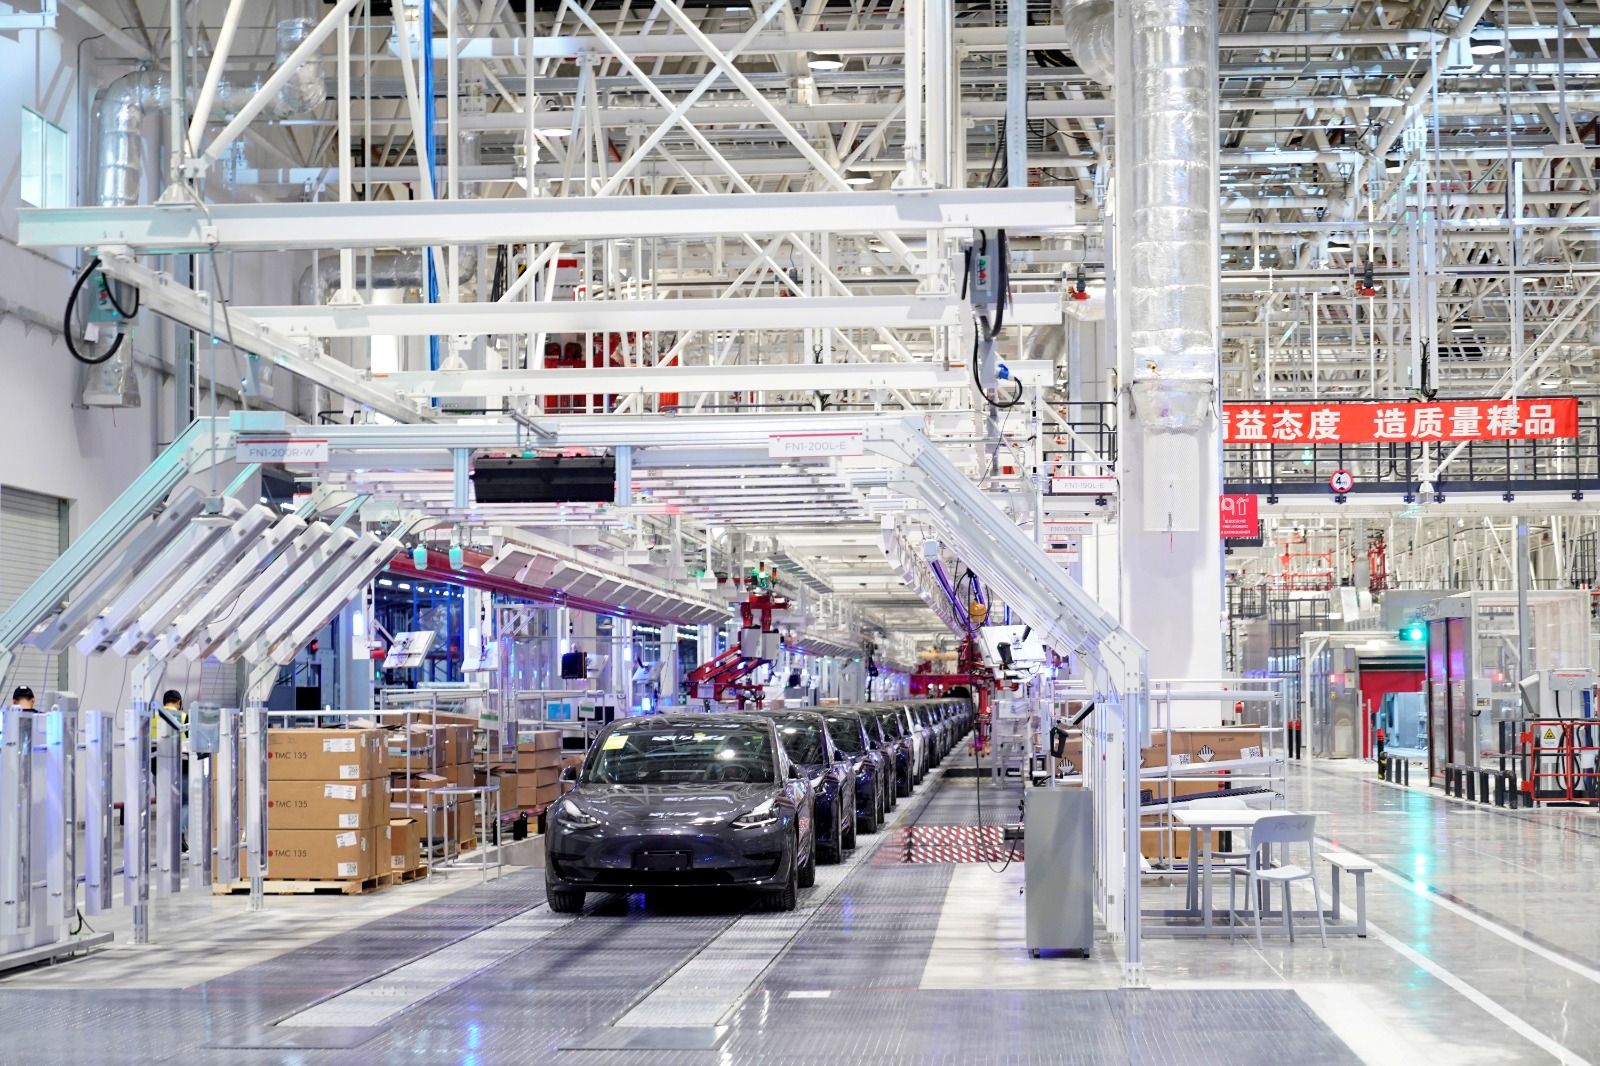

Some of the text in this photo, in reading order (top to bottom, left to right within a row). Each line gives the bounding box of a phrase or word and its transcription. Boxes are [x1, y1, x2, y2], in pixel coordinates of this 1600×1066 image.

[1374, 404, 1556, 439] 造质量精品
[785, 441, 847, 451] FN1-200L-E
[249, 448, 314, 457] FN1-200R-W
[275, 800, 307, 808] TMC 135
